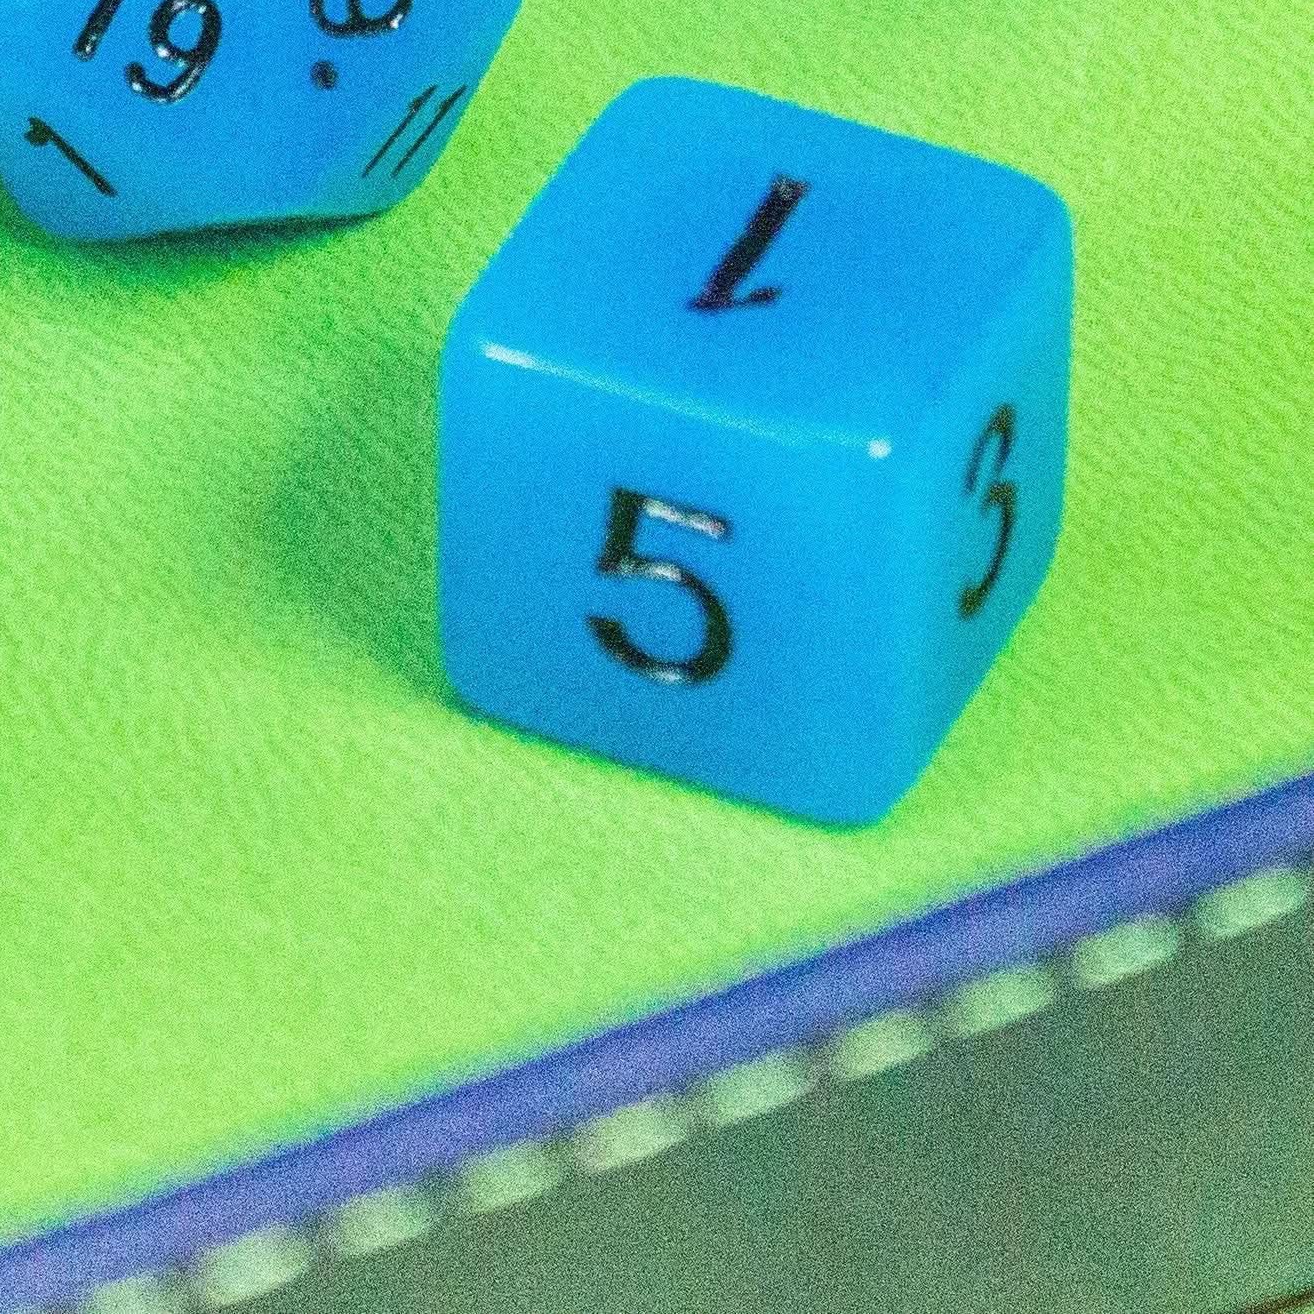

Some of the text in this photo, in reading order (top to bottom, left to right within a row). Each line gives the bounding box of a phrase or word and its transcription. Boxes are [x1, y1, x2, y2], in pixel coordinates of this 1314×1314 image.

[23, 118, 116, 196] 1
[686, 174, 810, 312] 1
[589, 488, 733, 686] 5
[960, 404, 1016, 619] 3
